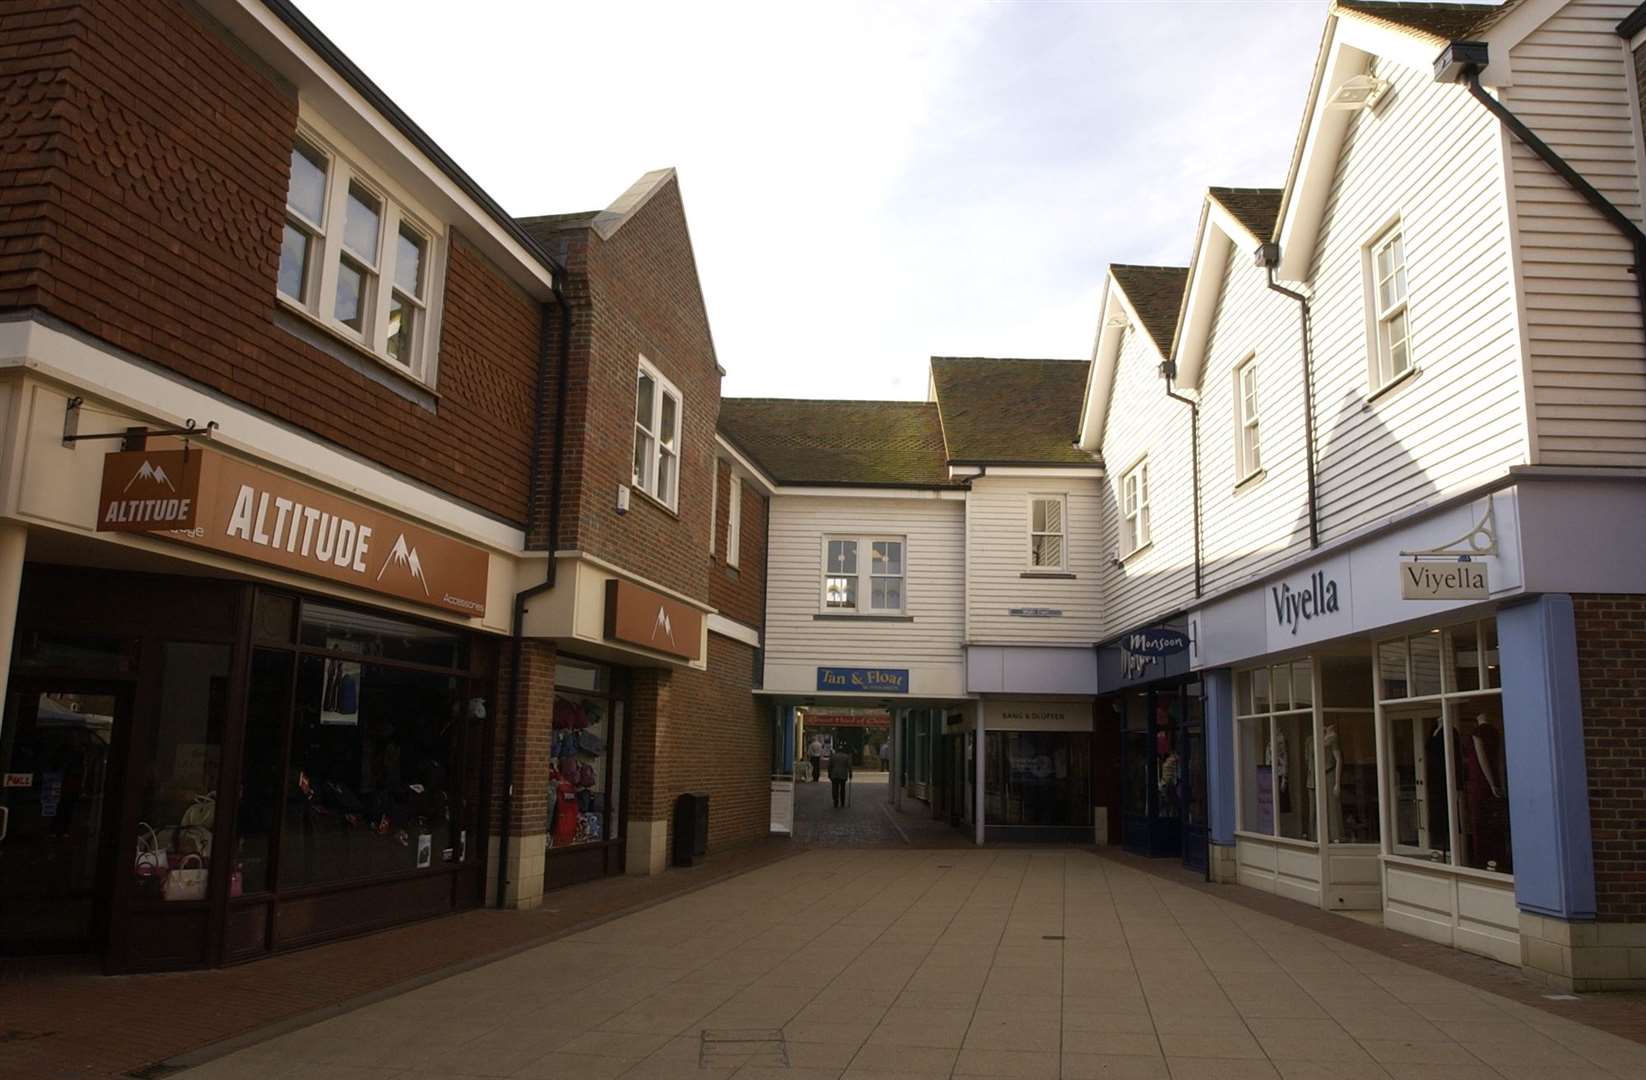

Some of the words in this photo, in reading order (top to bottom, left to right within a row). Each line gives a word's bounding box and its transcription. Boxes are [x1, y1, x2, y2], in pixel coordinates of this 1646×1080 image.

[105, 498, 191, 522] ALTITUDE
[226, 484, 372, 573] ALTITUDE
[1408, 566, 1484, 594] Viyella
[1272, 569, 1339, 635] Viyella
[1130, 634, 1184, 652] Monsoon
